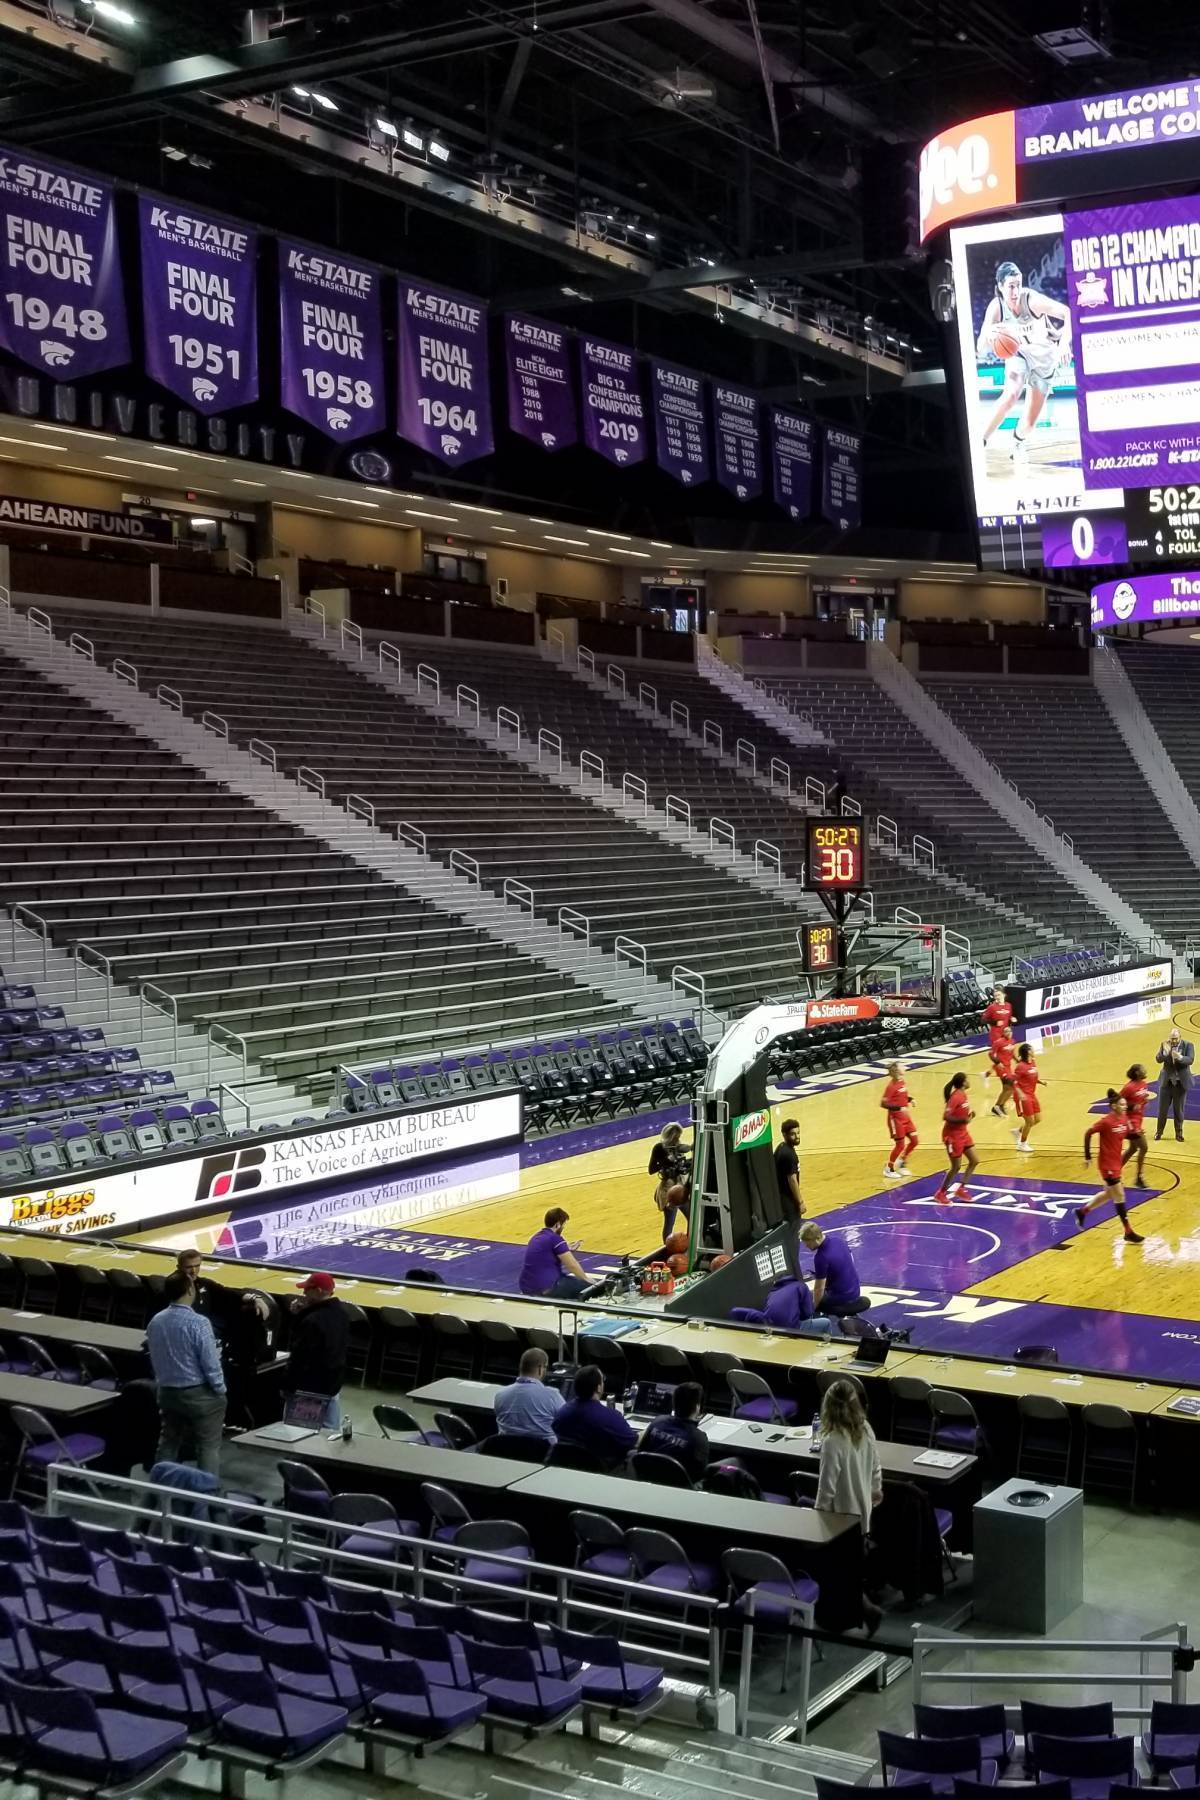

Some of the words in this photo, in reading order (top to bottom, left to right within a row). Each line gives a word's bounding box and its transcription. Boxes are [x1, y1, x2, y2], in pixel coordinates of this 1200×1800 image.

[1082, 87, 1190, 122] WELCOME
[1024, 119, 1155, 157] BRAMLAGE
[31, 189, 97, 217] BASKETBALL
[7, 214, 93, 260] FINAL
[150, 206, 248, 254] K-STATE
[158, 229, 186, 246] MEN'S
[188, 238, 242, 262] BASKETBALL
[8, 241, 93, 286] FOUR
[1071, 237, 1101, 272] BIG
[1100, 233, 1121, 268] 12
[167, 261, 236, 302] FINAL
[287, 249, 372, 292] K-STATE
[294, 270, 319, 286] MEN'S
[319, 275, 368, 300] BASKETBALL
[1111, 265, 1136, 308] IN
[6, 293, 108, 341] 1948
[168, 286, 235, 327] FOUR
[301, 300, 364, 339] FINAL
[406, 288, 480, 327] K-STATE
[412, 307, 434, 320] MEN'S
[434, 312, 477, 334] BASKETBALL
[302, 324, 363, 360] FOUR
[510, 320, 562, 348] K-STATE
[168, 334, 240, 380] 1951
[419, 335, 473, 371] FINAL
[516, 357, 538, 371] ELITE
[538, 363, 564, 379] EIGHT
[585, 341, 632, 368] K-STATE
[302, 368, 374, 409] 1958
[420, 359, 473, 391] FOUR
[597, 373, 613, 387] BIG
[613, 378, 626, 391] 12
[656, 368, 699, 391] K-STATE
[588, 383, 640, 404] CONFERENCE
[588, 393, 643, 418] CHAMPIONS
[659, 399, 703, 419] CHAMPIONSHIPS
[663, 393, 697, 410] CONFERENCE
[716, 388, 755, 410] K-STATE
[17, 376, 304, 466] UNIVERSITY
[417, 397, 478, 437] 1964
[599, 418, 639, 442] 2019
[722, 411, 753, 428] CONFERENCE
[774, 413, 811, 434] K-STATE
[827, 429, 860, 450] K-STATE
[1126, 441, 1151, 452] PACK
[1154, 440, 1167, 449] KC
[1168, 438, 1193, 448] WITH
[1016, 494, 1082, 512] K-STATE
[1071, 517, 1094, 560] 0
[1155, 531, 1163, 541] 4
[1174, 528, 1197, 540] TOL
[1156, 544, 1163, 555] 0
[815, 828, 858, 846] 50:27
[822, 849, 853, 881] 30
[813, 945, 827, 964] 30
[1062, 981, 1085, 995] KANSAS
[1085, 978, 1102, 990] FARM
[273, 1129, 346, 1163] KANSAS
[351, 1118, 400, 1146] FARM
[407, 1104, 479, 1134] BUREAU
[735, 1112, 766, 1147] LIBMAN
[273, 1163, 302, 1183] The
[307, 1156, 347, 1175] Voice
[351, 1149, 366, 1164] of
[10, 1189, 96, 1221] Briggs
[66, 1212, 116, 1233] SAVINGS
